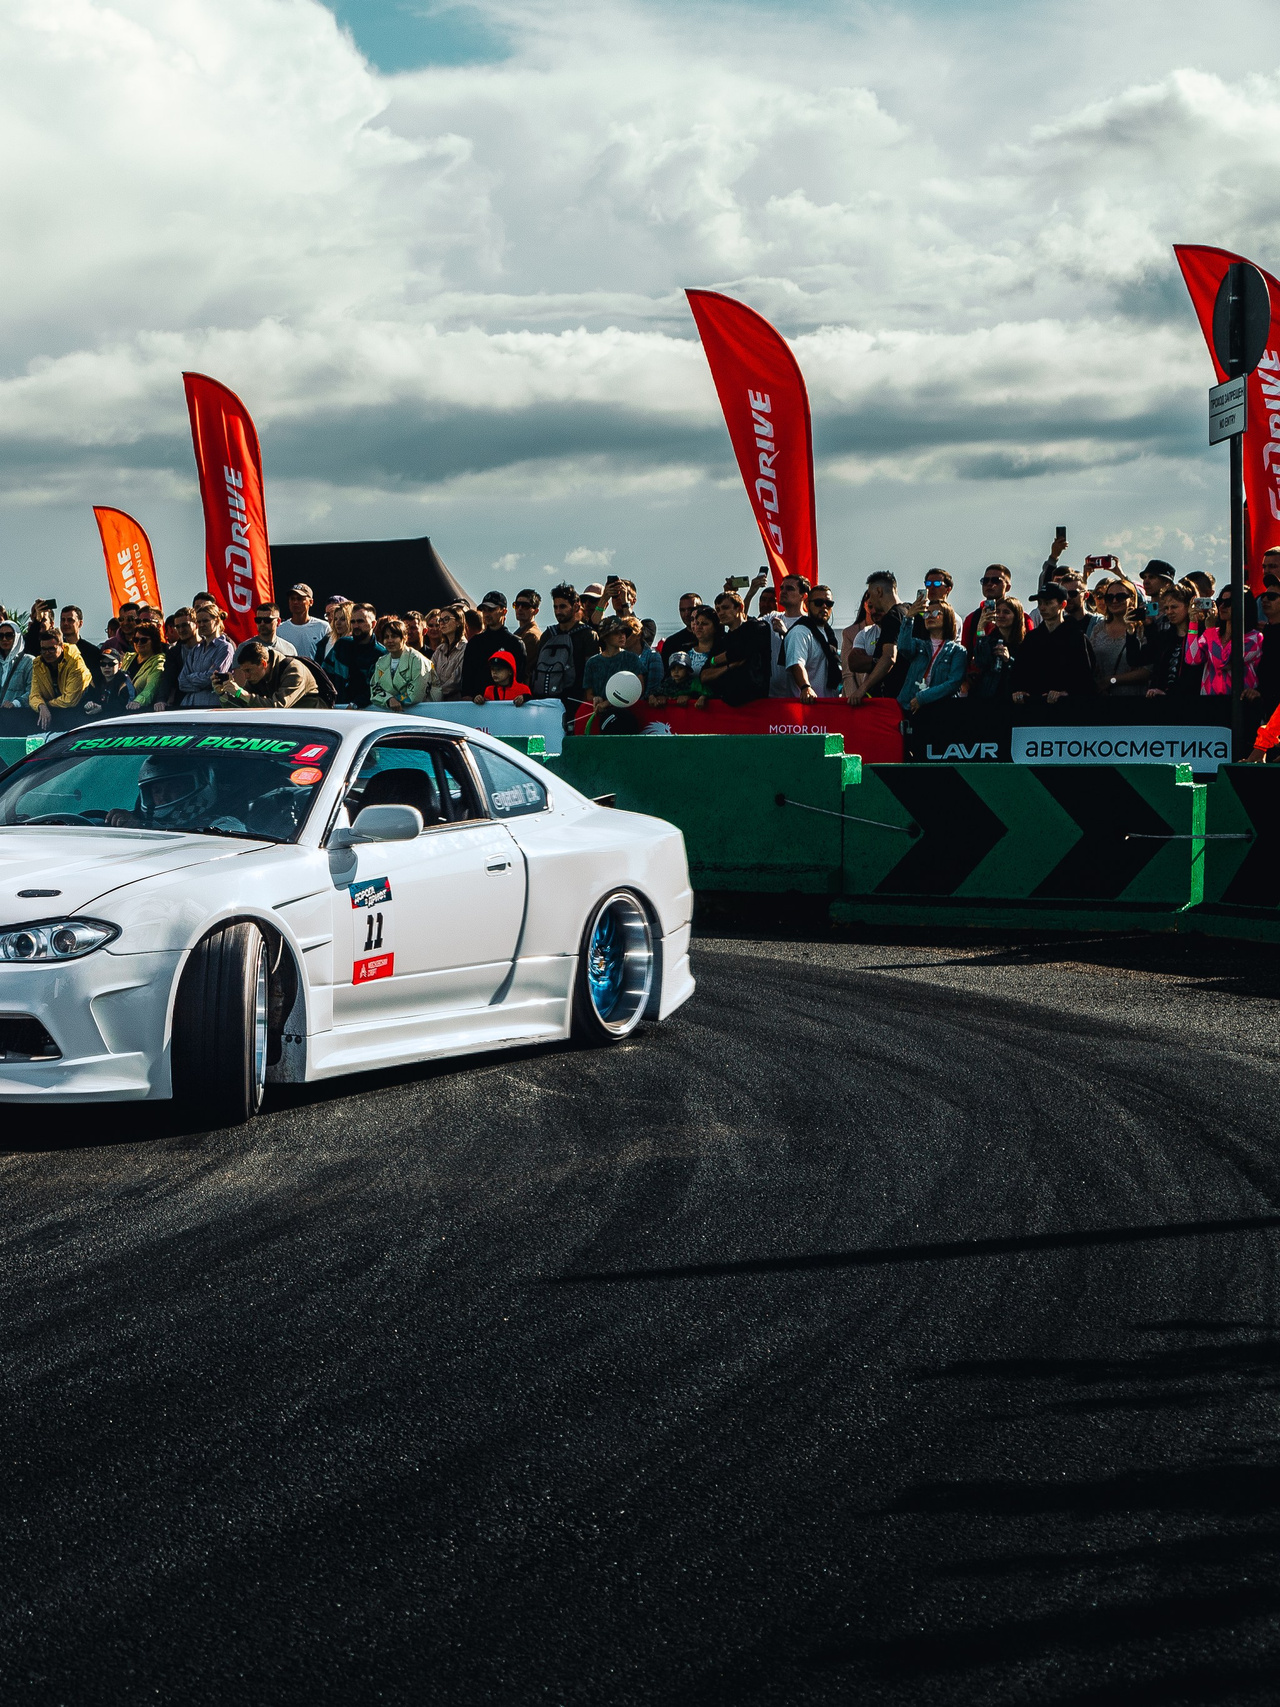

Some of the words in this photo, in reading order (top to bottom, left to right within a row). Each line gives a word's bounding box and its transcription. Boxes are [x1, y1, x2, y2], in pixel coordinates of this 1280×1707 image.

[769, 724, 808, 734] MOTOR
[70, 735, 195, 751] TSUNAMI
[196, 736, 298, 753] PICNIC
[926, 742, 999, 760] LAVR
[1025, 740, 1228, 759] автокосметика
[364, 912, 384, 951] 11
